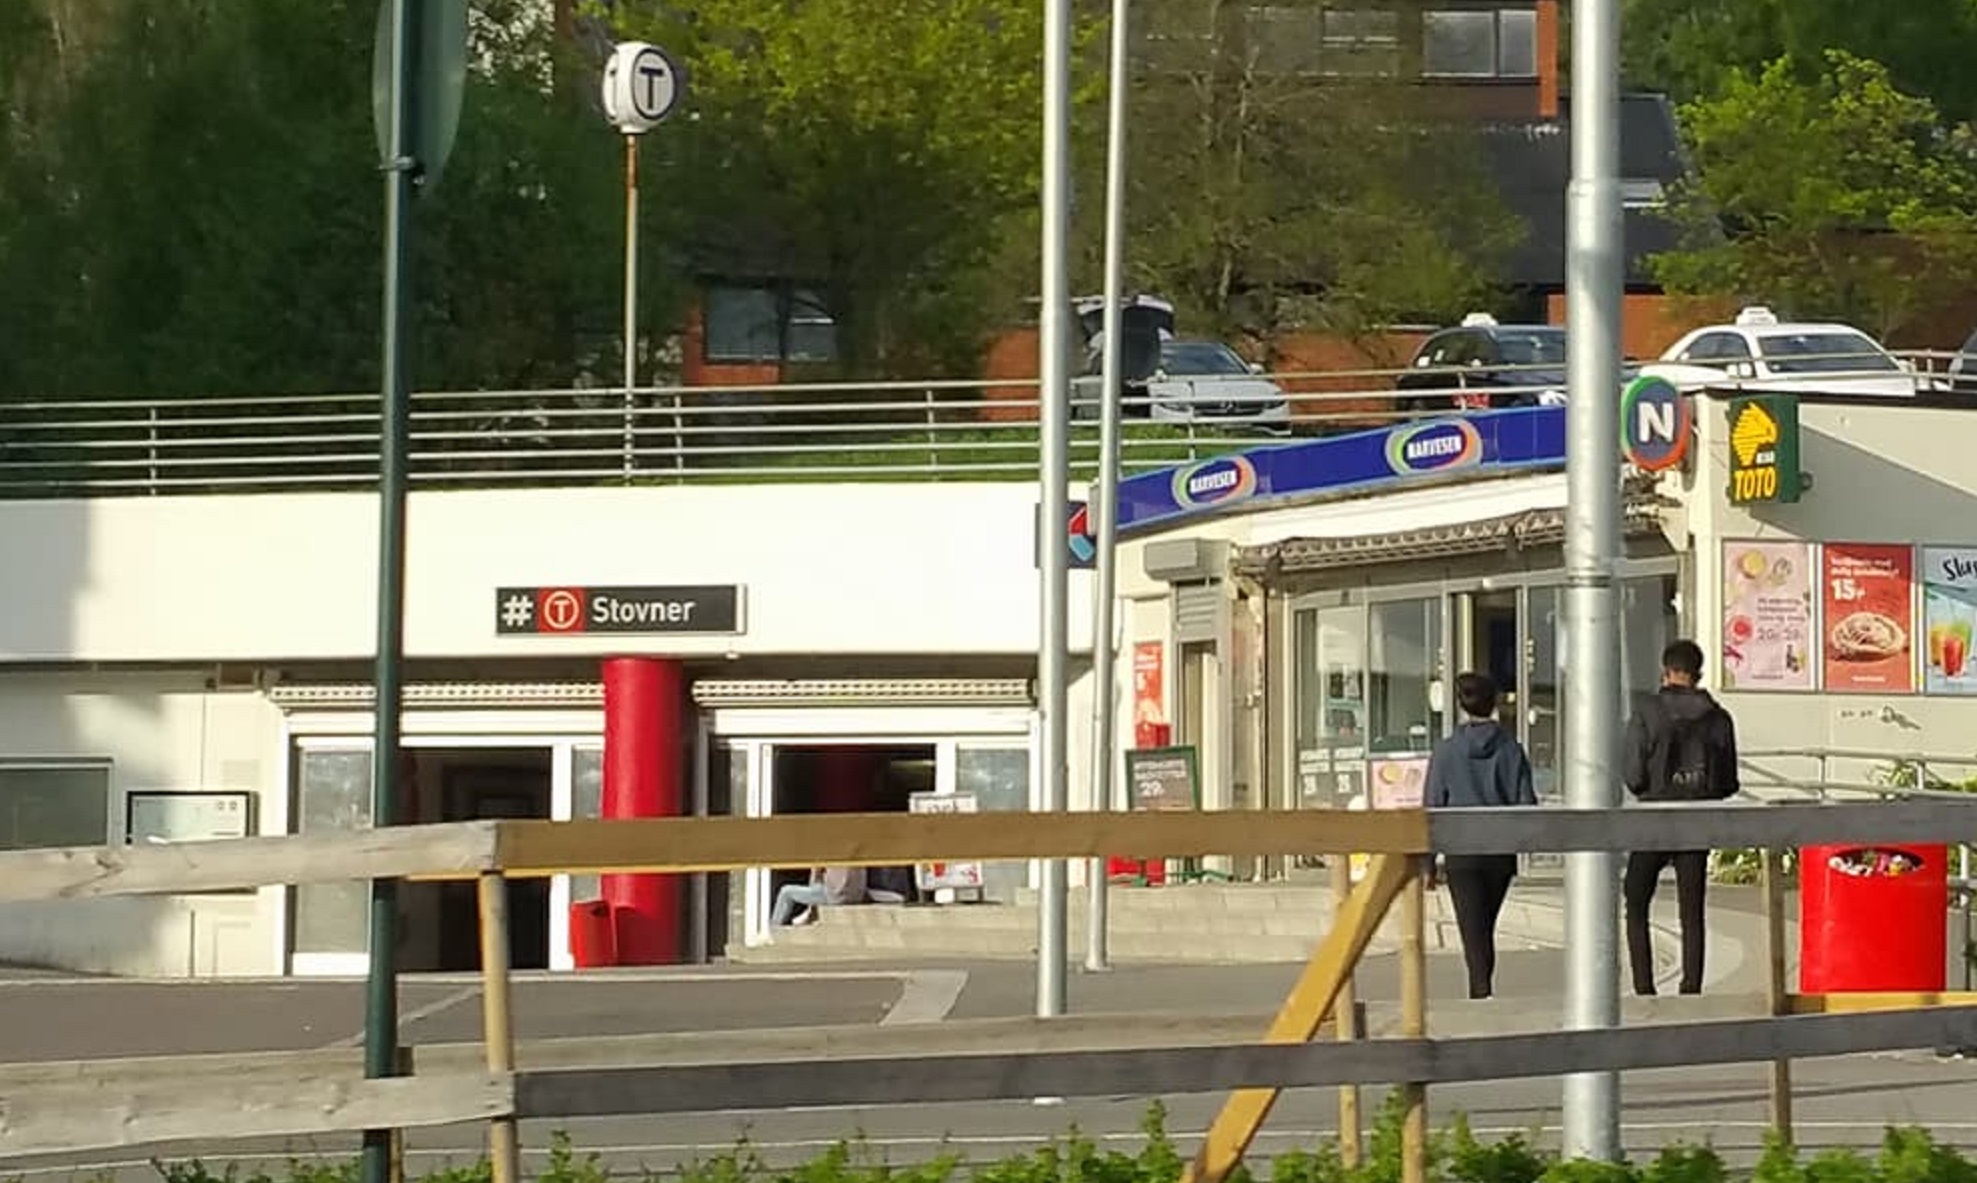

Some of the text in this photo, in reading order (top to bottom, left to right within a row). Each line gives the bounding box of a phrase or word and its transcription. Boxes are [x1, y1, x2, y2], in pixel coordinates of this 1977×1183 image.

[640, 66, 664, 110] T
[1638, 402, 1674, 442] N
[1734, 466, 1776, 500] TOTO
[592, 597, 696, 623] Stovner
